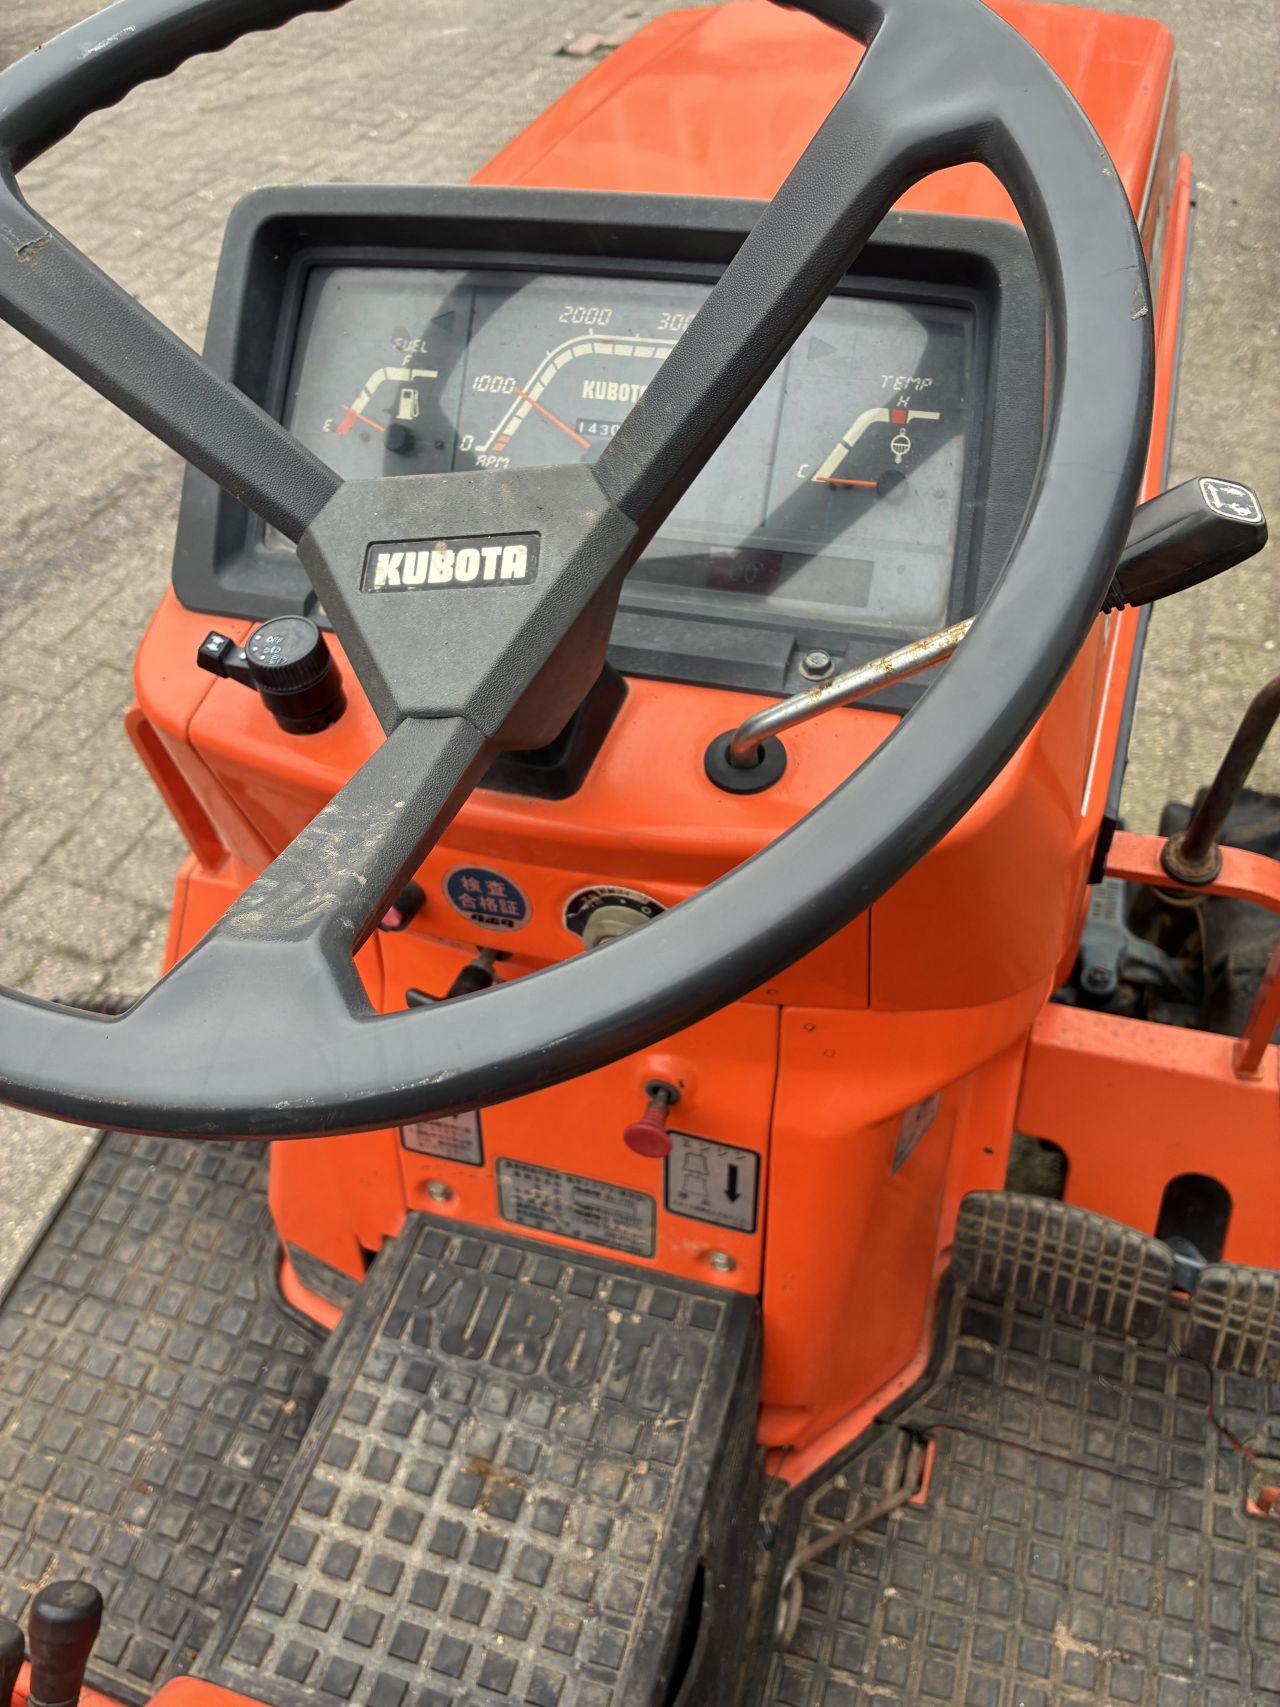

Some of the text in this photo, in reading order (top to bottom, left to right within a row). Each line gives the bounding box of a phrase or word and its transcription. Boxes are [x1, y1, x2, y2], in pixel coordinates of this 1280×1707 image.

[559, 306, 612, 325] 2000
[402, 355, 412, 366] F
[472, 375, 516, 393] 1000
[881, 375, 933, 391] TEMP
[896, 396, 910, 407] H
[323, 419, 333, 432] E
[460, 435, 474, 452] 0
[475, 455, 510, 469] RPM
[797, 464, 809, 478] C
[374, 545, 528, 587] KUBOTA
[460, 876, 507, 898] 検査
[458, 893, 520, 916] 合格証
[384, 1268, 709, 1419] KUBOTA
